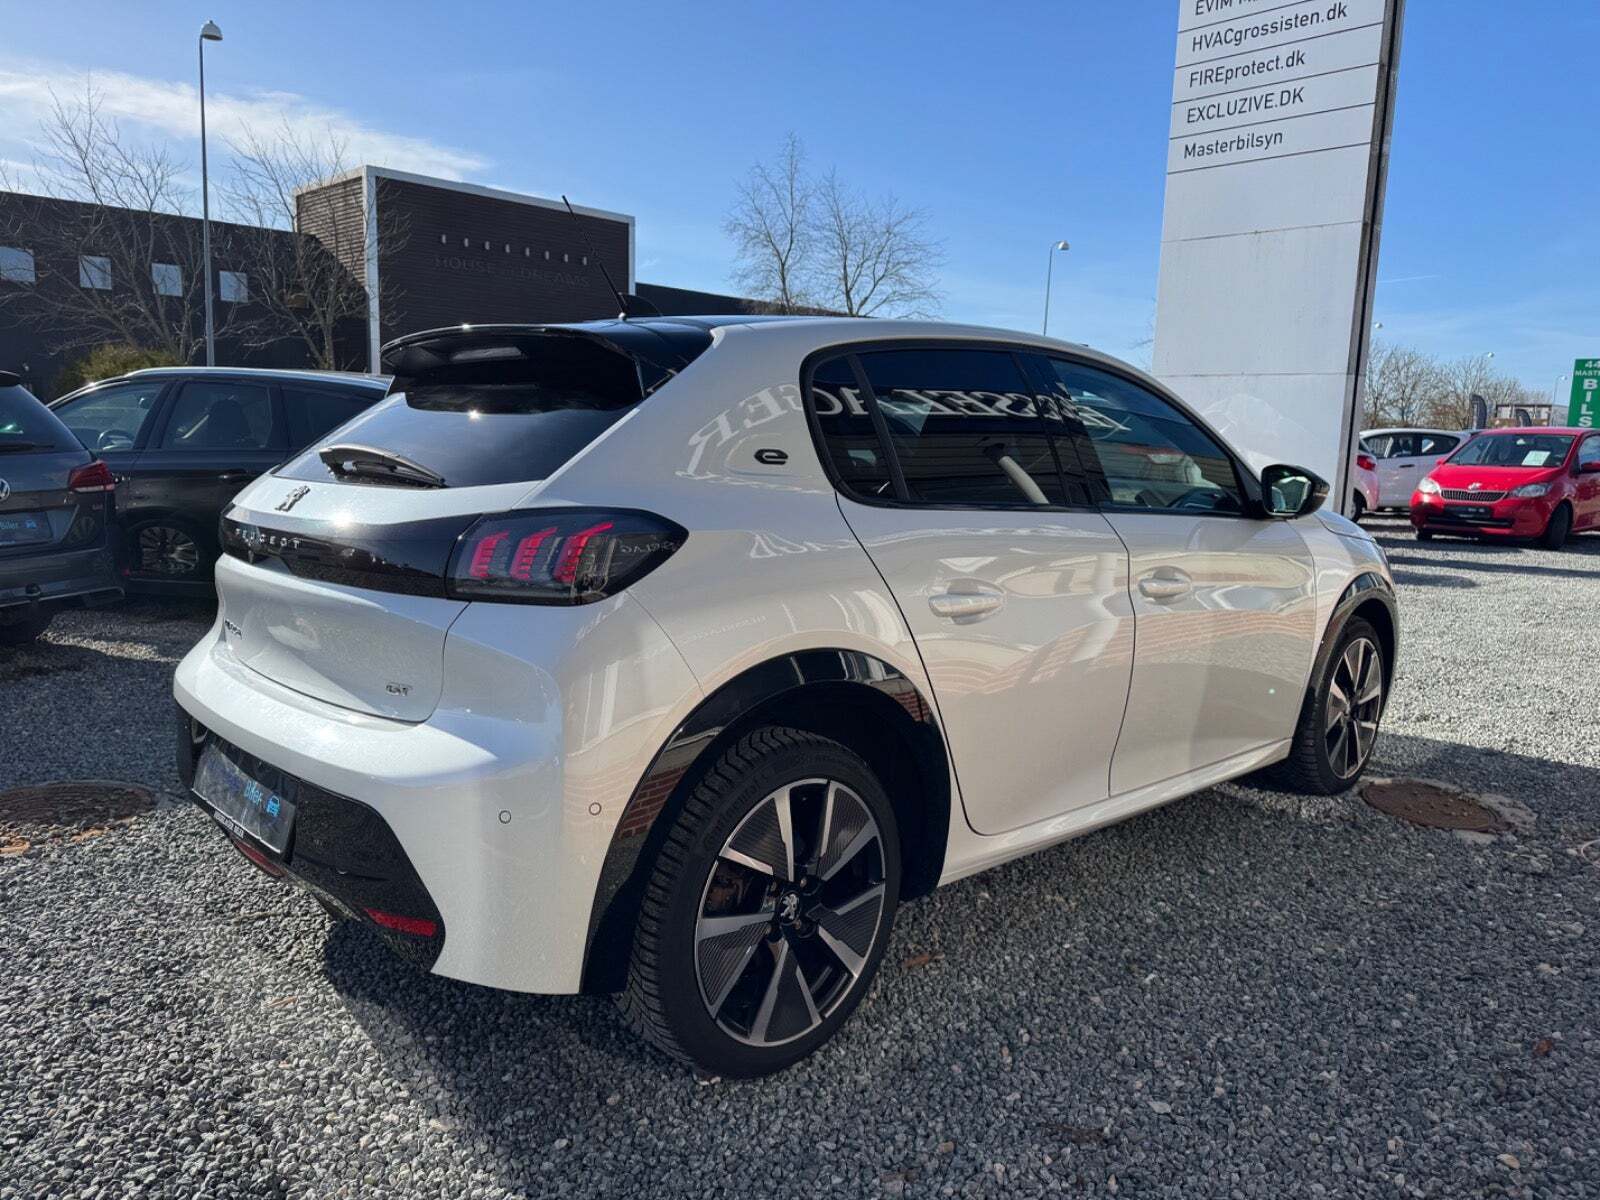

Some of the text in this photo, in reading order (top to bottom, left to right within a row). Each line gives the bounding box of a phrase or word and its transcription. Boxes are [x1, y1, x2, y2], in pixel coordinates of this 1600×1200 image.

[1191, 3, 1348, 52] HVACgrossisten.dk
[1188, 49, 1307, 88] FIREprotect.dk
[1186, 86, 1305, 124] EXCLUZIVE.DK
[1183, 131, 1283, 159] Masterbilsyn
[234, 527, 301, 550] PEUGEOT
